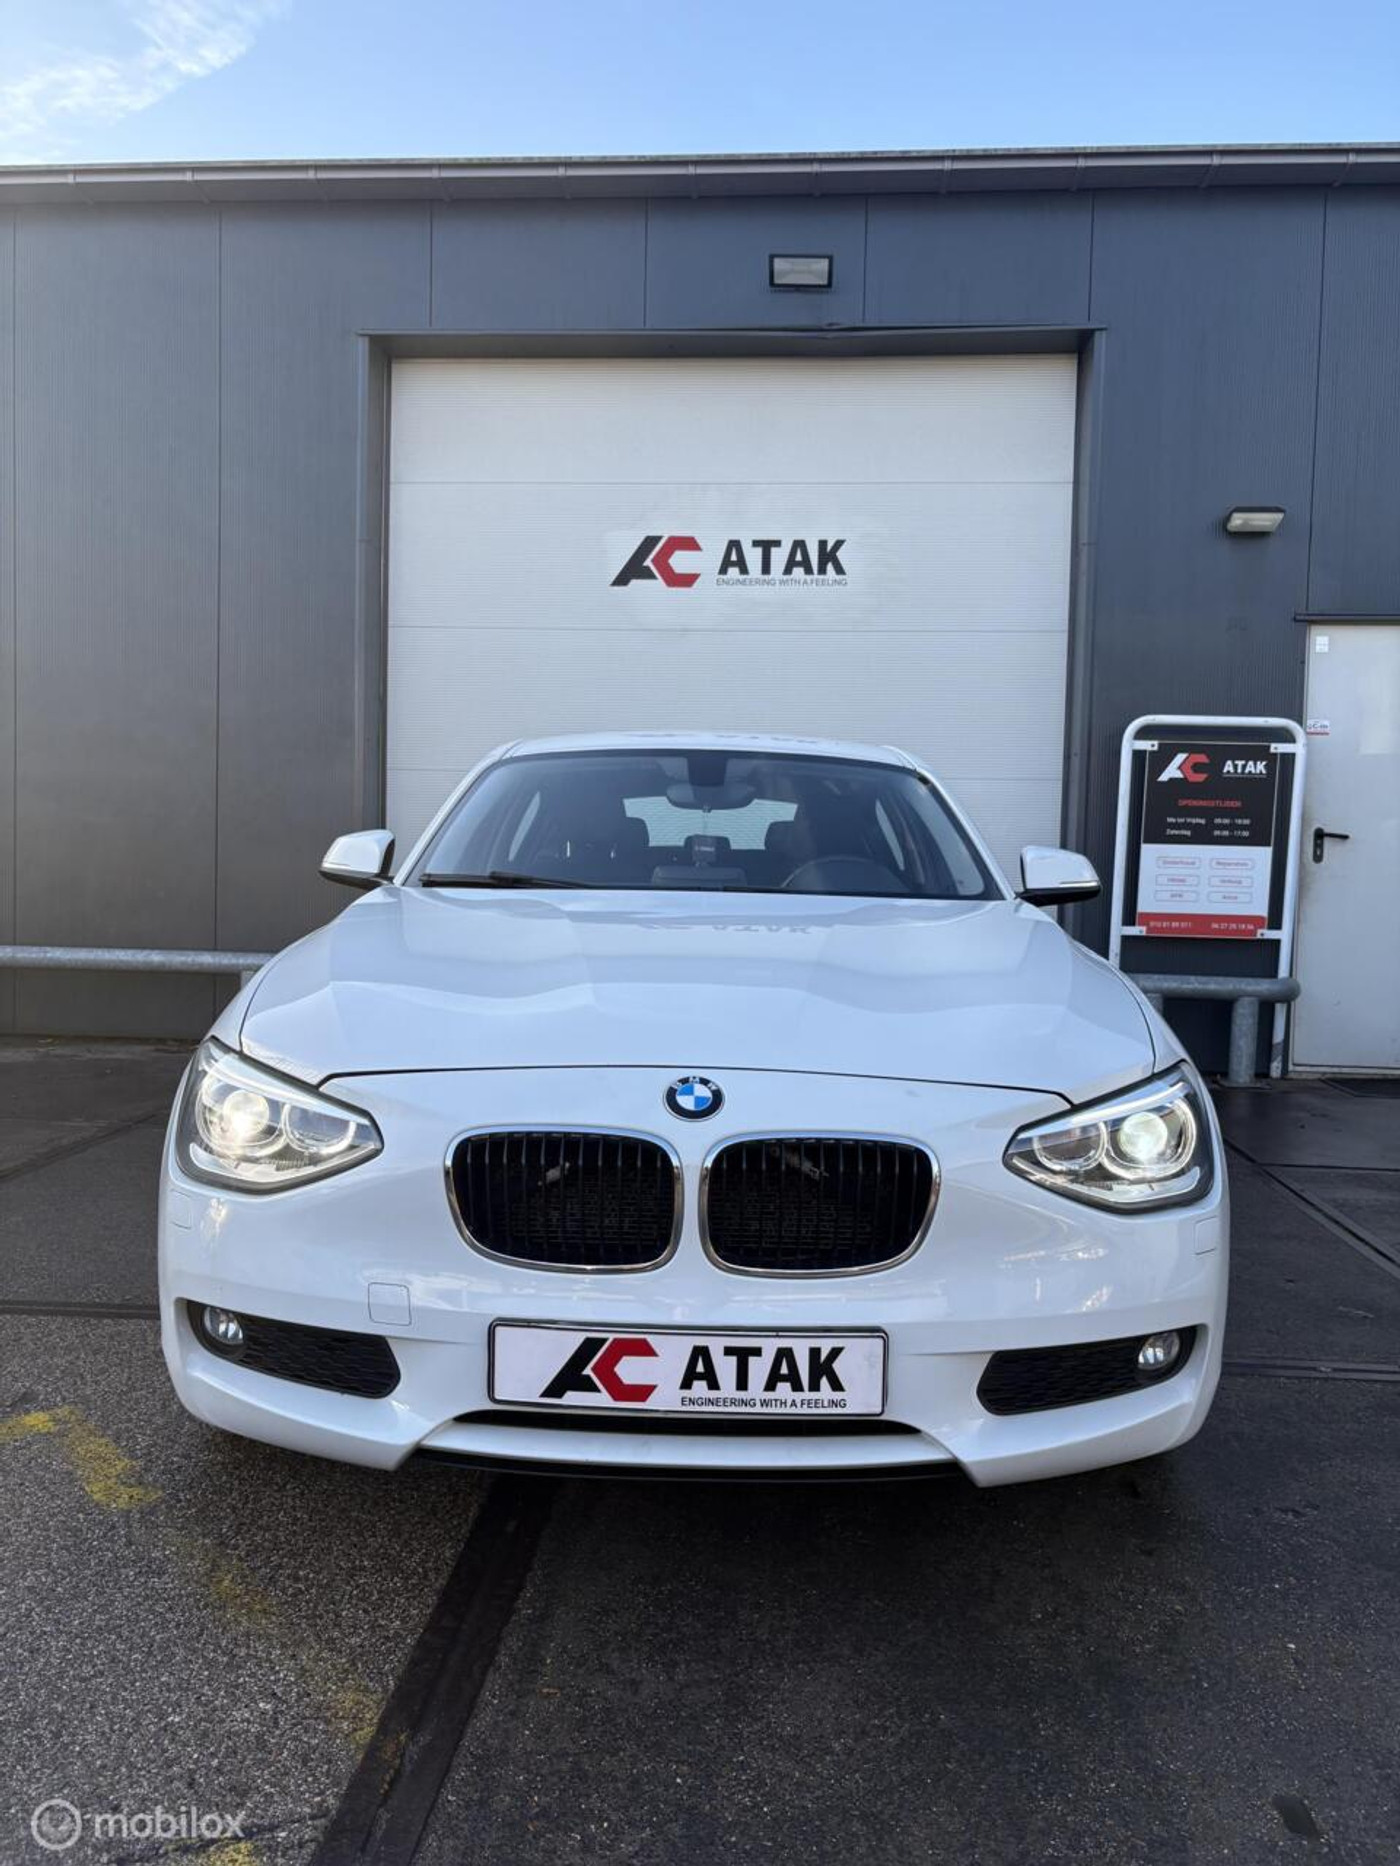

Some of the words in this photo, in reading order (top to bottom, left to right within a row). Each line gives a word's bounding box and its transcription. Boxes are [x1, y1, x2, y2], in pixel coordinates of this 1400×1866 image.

[717, 539, 847, 576] ATAK
[716, 577, 776, 587] ENGINEERING
[778, 578, 800, 587] WITH
[810, 578, 848, 587] FEELING
[1222, 760, 1268, 774] ATAK
[670, 1076, 720, 1091] BMW
[679, 1345, 846, 1392] ATAK
[681, 1396, 757, 1408] ENGINEERING
[760, 1399, 788, 1409] WITH
[789, 1399, 798, 1409] A
[800, 1399, 847, 1409] FEELING
